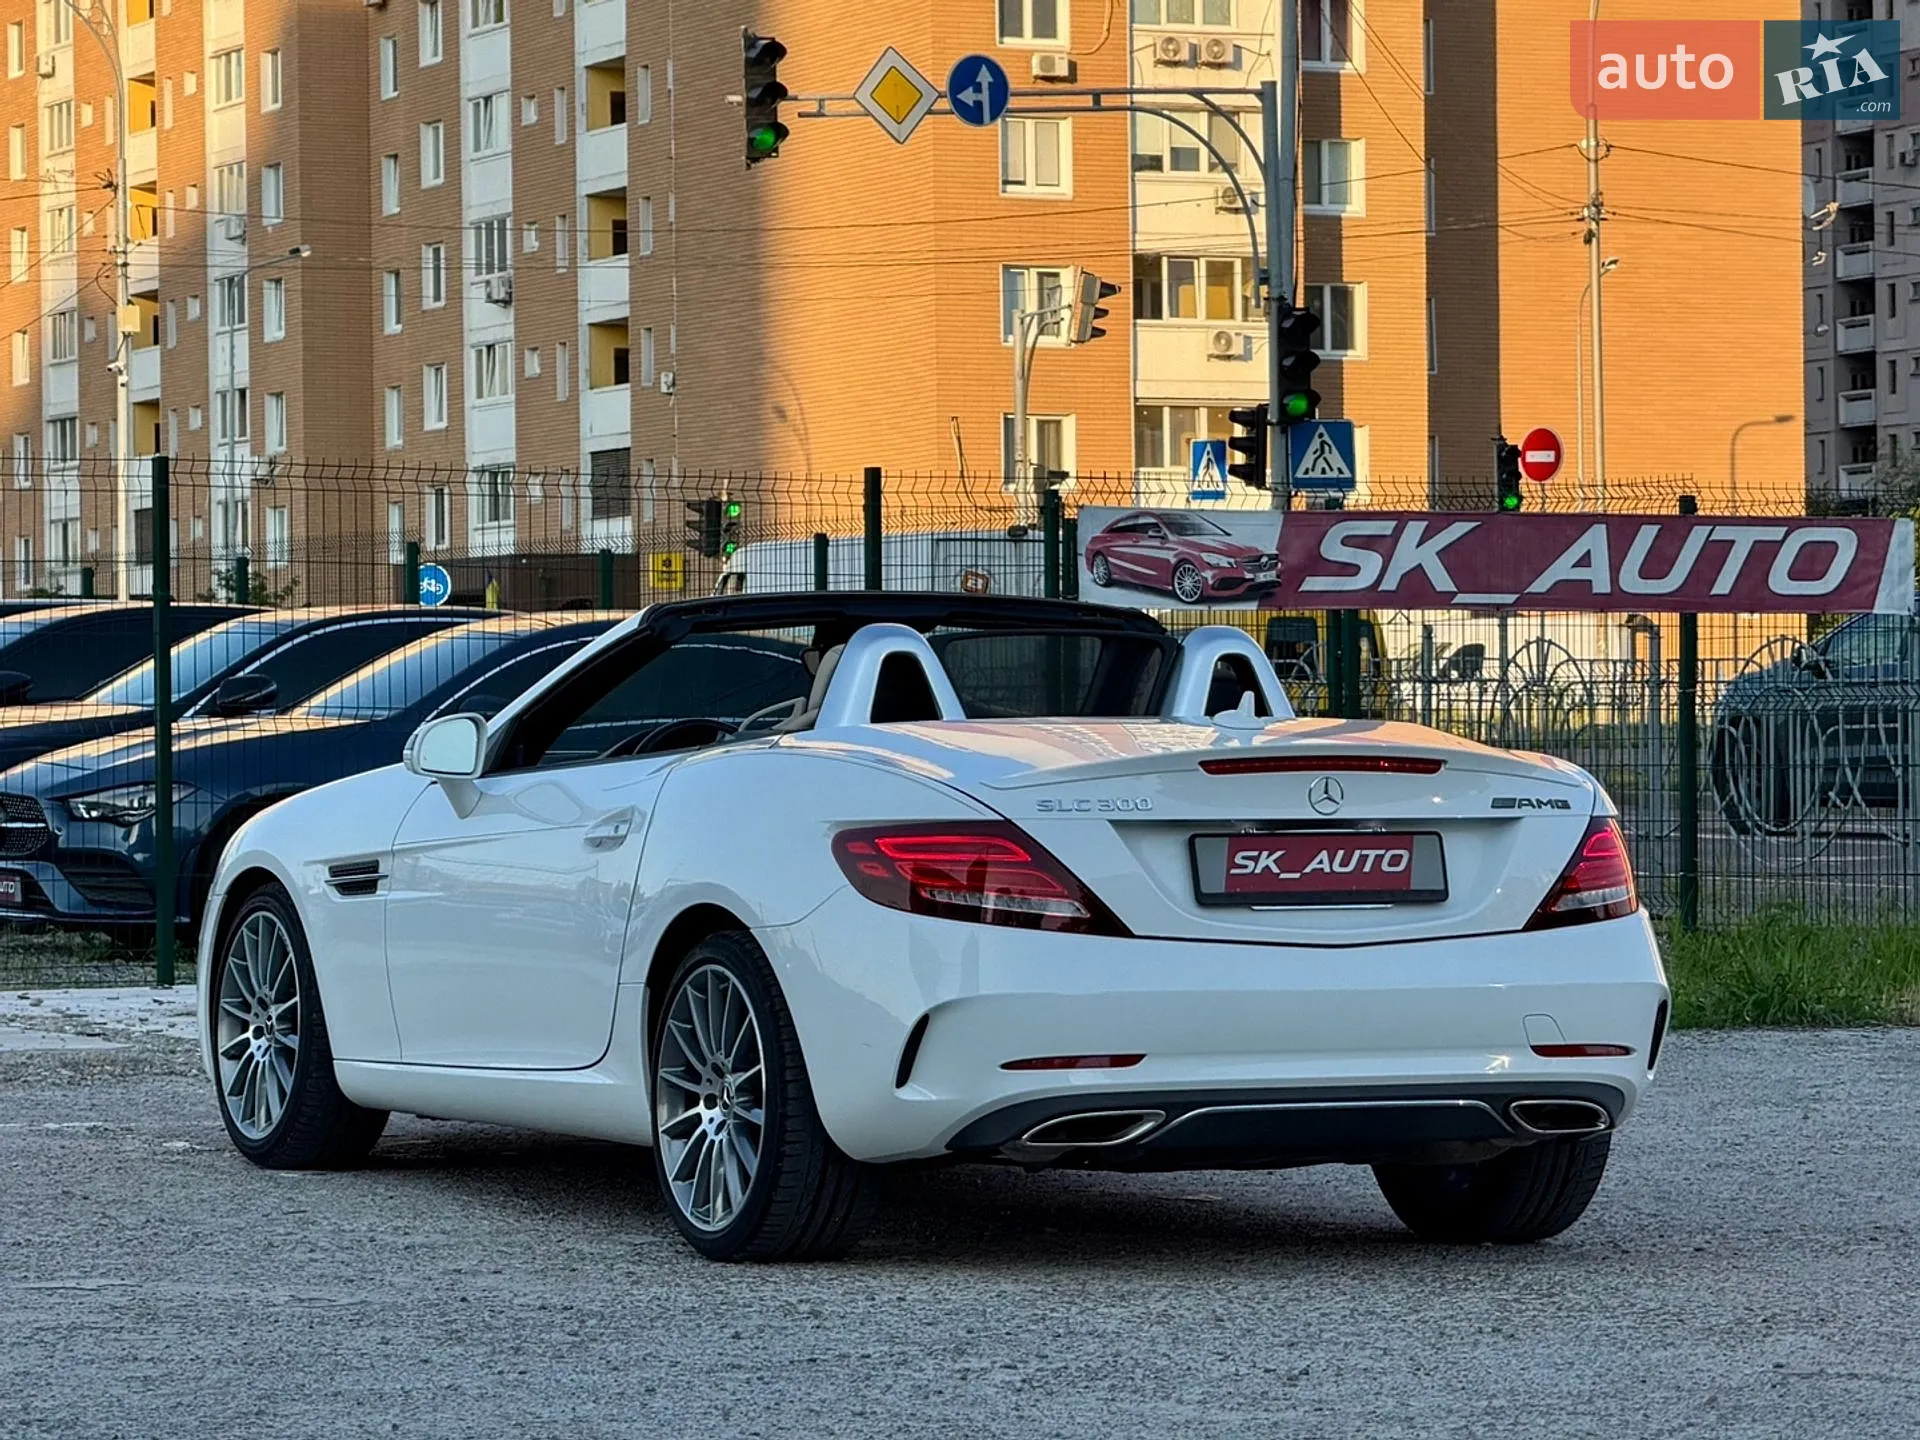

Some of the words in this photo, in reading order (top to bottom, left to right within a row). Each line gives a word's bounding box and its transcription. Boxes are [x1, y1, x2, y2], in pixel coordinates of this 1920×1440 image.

[1298, 520, 1858, 604] SK_AUTO
[1036, 799, 1091, 812] SLC
[1097, 797, 1153, 812] 300
[1517, 797, 1571, 810] AMG
[1230, 849, 1410, 879] SK_AUTO
